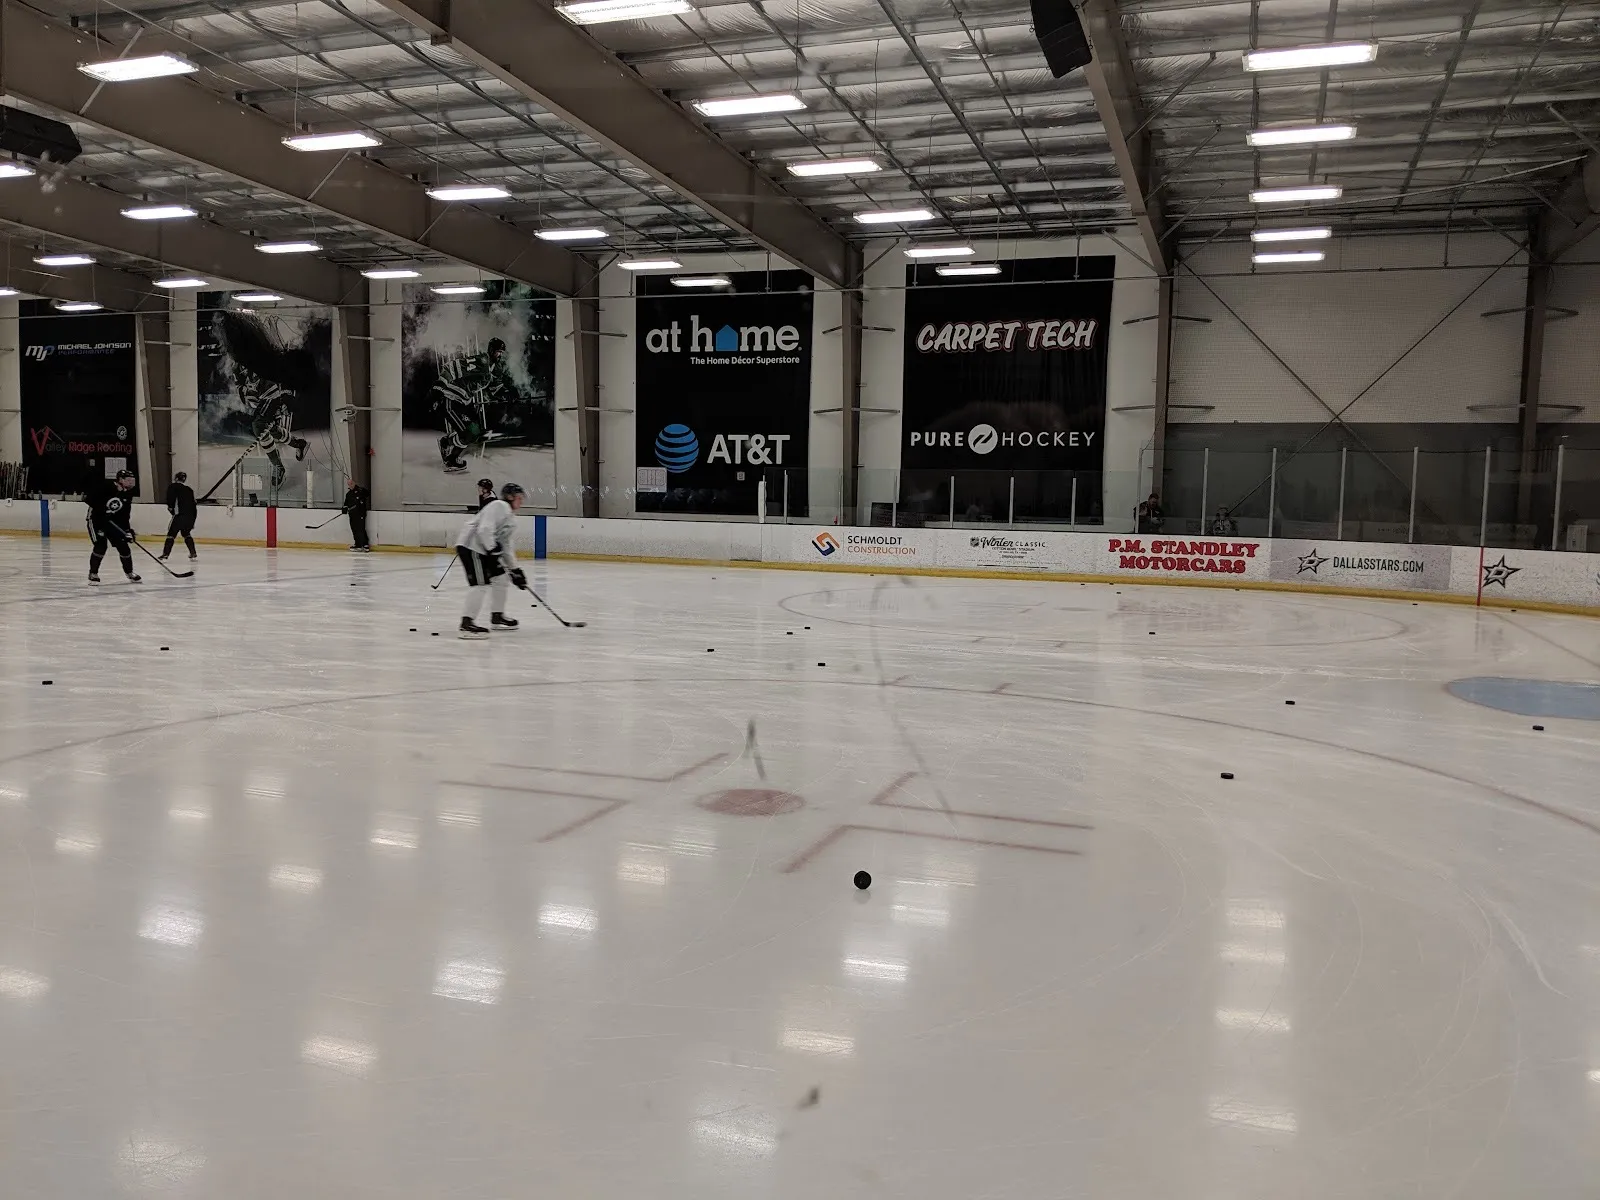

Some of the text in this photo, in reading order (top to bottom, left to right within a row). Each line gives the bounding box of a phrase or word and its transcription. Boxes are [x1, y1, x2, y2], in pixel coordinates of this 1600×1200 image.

[645, 321, 682, 353] at
[916, 319, 1097, 352] CARPET TECH
[690, 356, 800, 366] The Home Décor Superstore
[30, 427, 66, 456] Valley
[68, 441, 96, 454] Ridge
[97, 441, 133, 455] Roofing
[910, 431, 1096, 447] PURE HOCKEY
[706, 434, 791, 465] AT&T
[847, 535, 903, 545] SCHMOLDT
[980, 535, 1014, 549] Winter
[1108, 539, 1260, 558] P.M. STANDLEY
[847, 546, 916, 555] CONSTRUCTION
[1118, 555, 1247, 573] MOTORCARS
[1332, 556, 1425, 573] DALLASSTARS.COM
